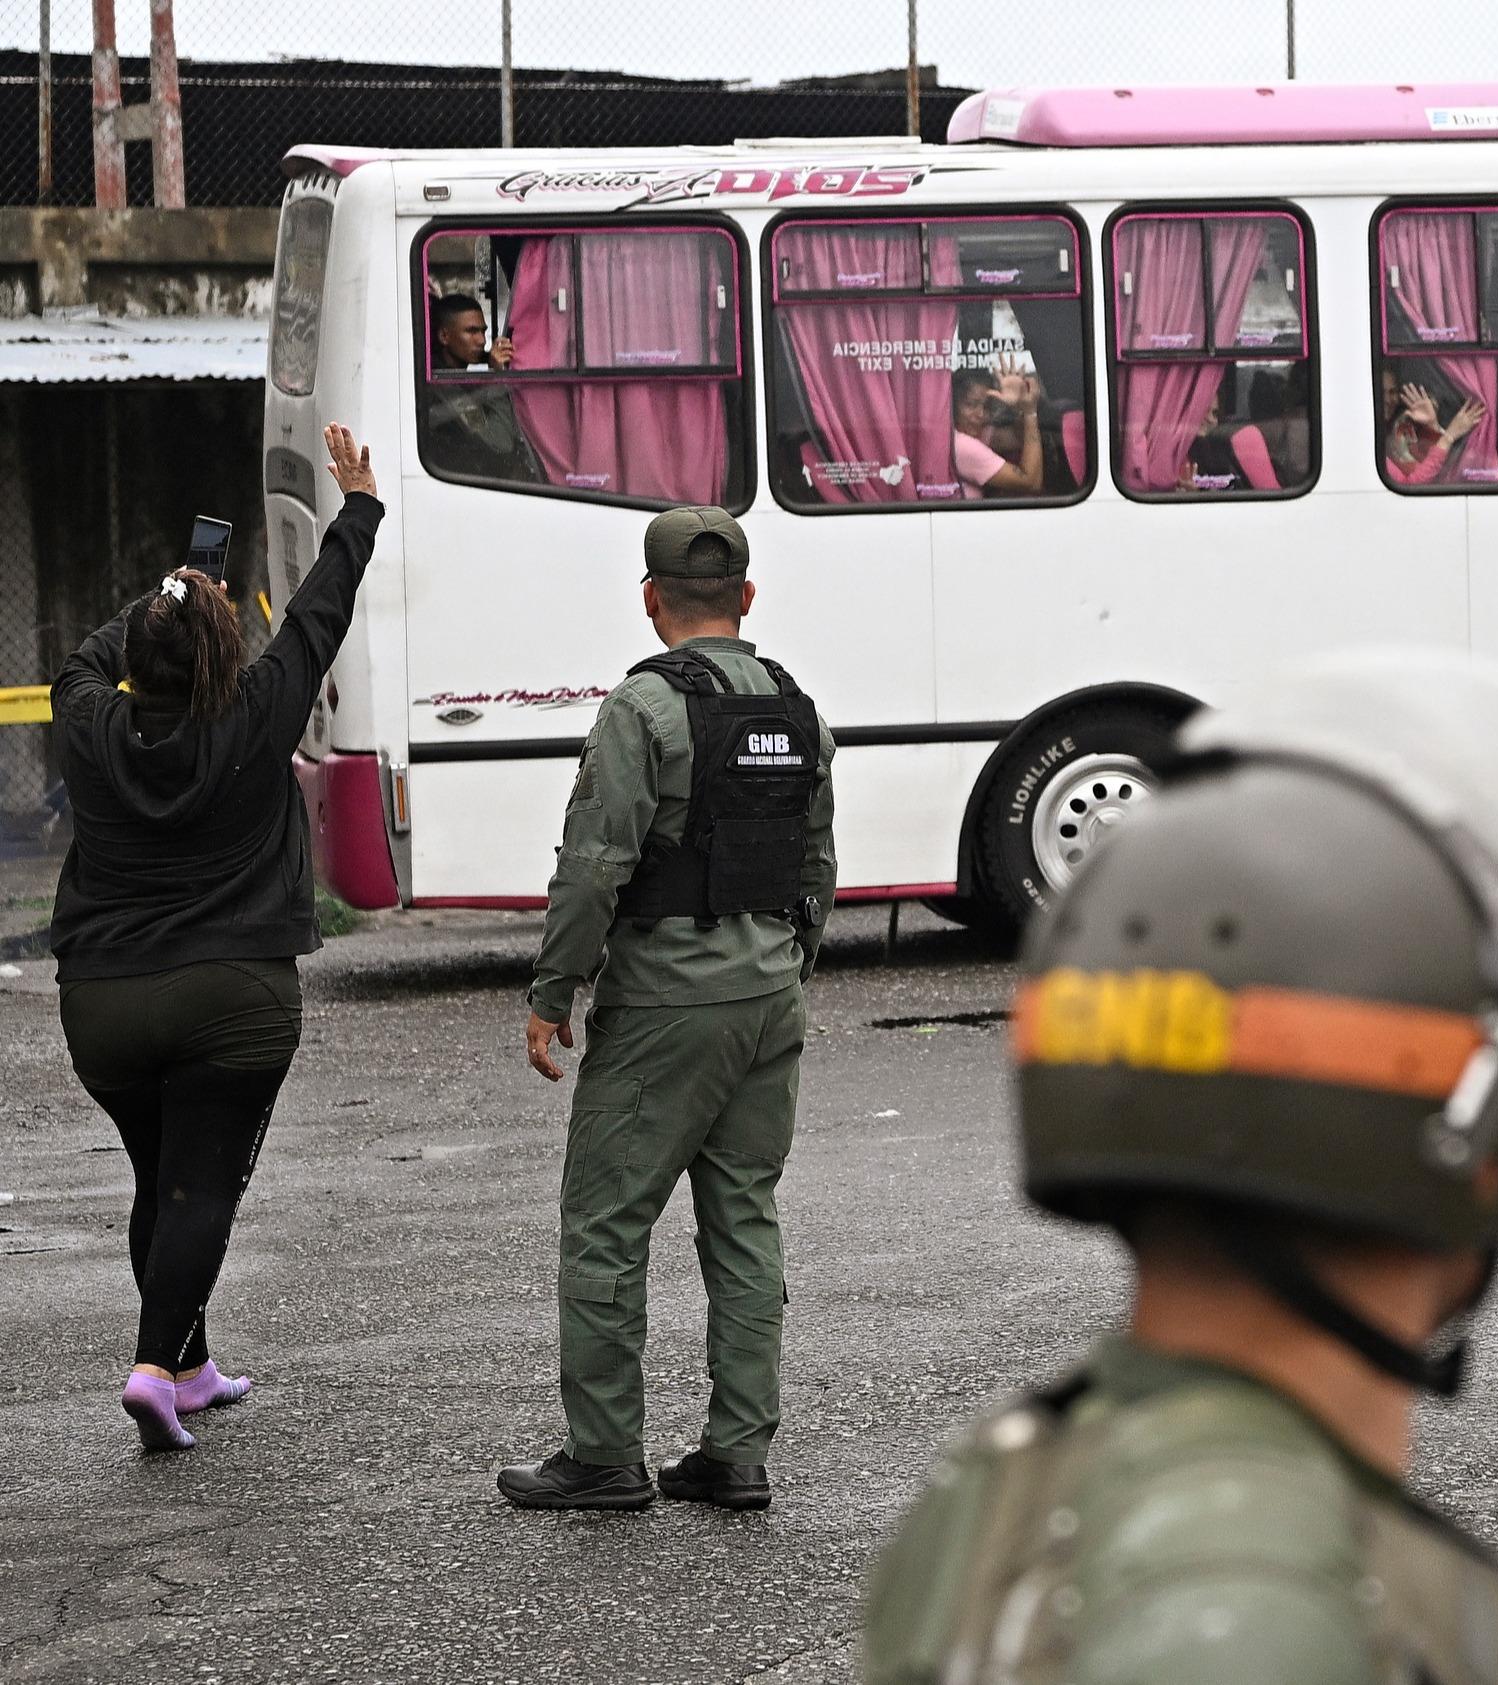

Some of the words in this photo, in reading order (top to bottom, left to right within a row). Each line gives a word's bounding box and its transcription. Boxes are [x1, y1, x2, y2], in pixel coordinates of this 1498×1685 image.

[497, 170, 641, 202] Gracias
[748, 733, 790, 754] GNB
[1009, 736, 1076, 824] LIONLIKE
[1036, 966, 1230, 1072] GNB
